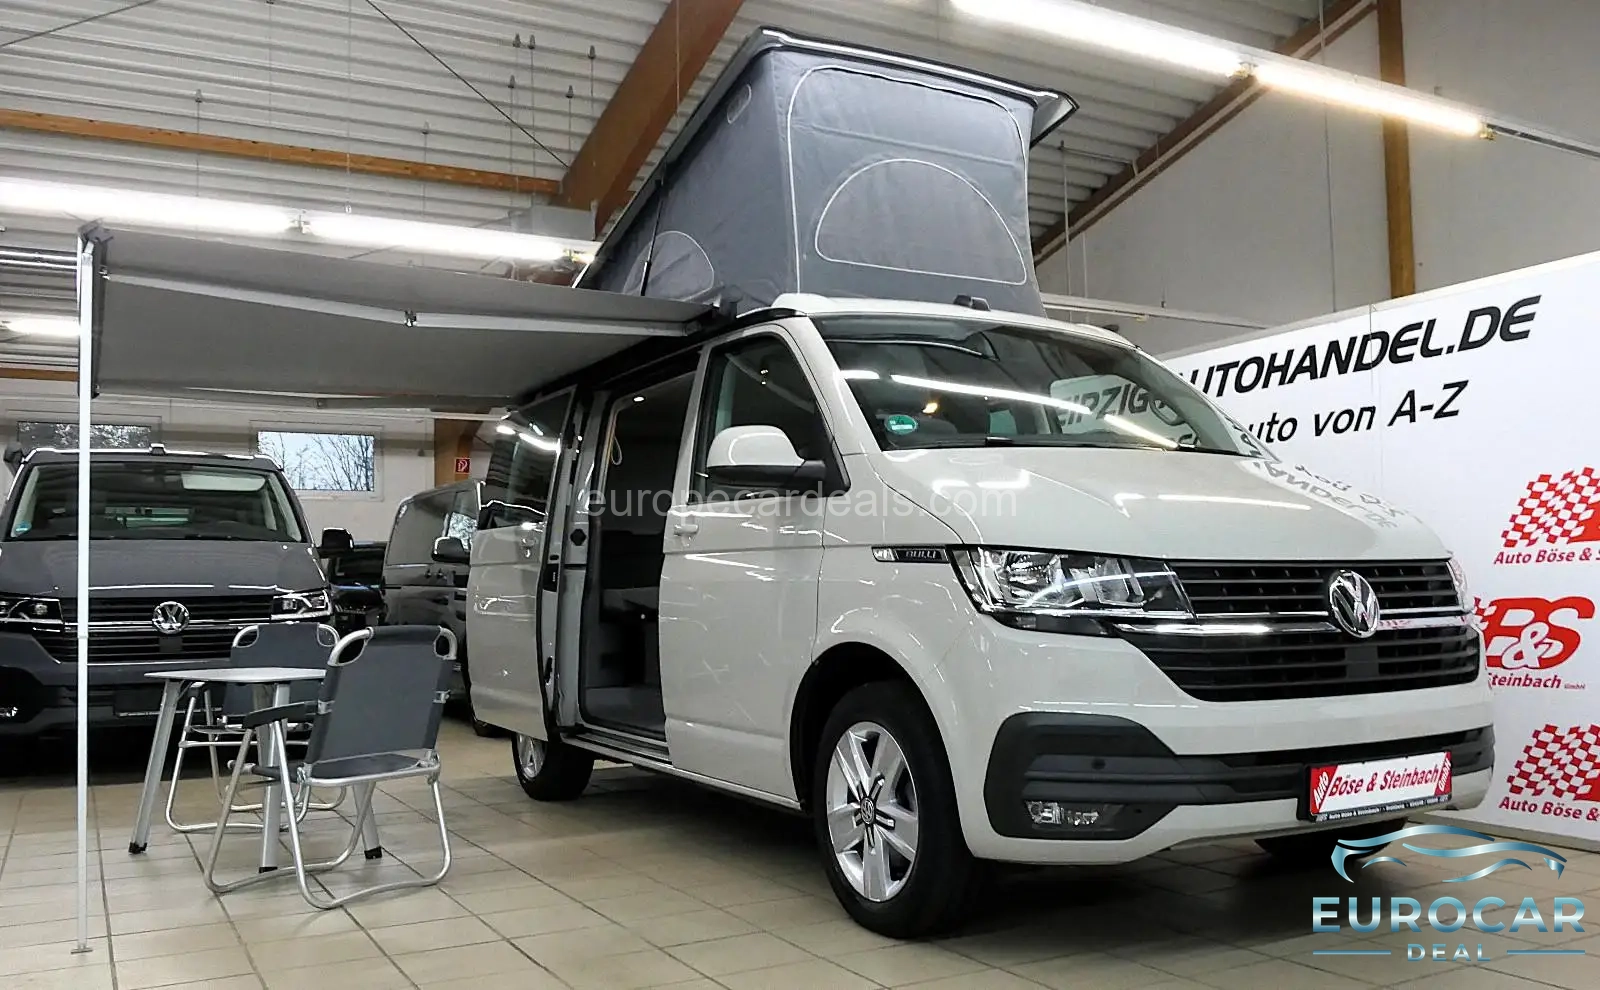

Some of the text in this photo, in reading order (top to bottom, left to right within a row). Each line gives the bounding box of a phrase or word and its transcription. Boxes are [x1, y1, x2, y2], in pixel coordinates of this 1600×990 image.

[1181, 295, 1542, 398] UTOHANDEL.DE
[1313, 405, 1376, 437] von
[1388, 380, 1469, 427] A-Z
[1494, 551, 1532, 565] Auto
[1535, 548, 1576, 563] Böse
[1579, 547, 1592, 561] &
[1313, 771, 1330, 810] Auto
[1328, 773, 1365, 797] Böse
[1366, 772, 1379, 793] &
[1379, 764, 1440, 791] Steinbach
[1499, 796, 1600, 822] Auto Böse &
